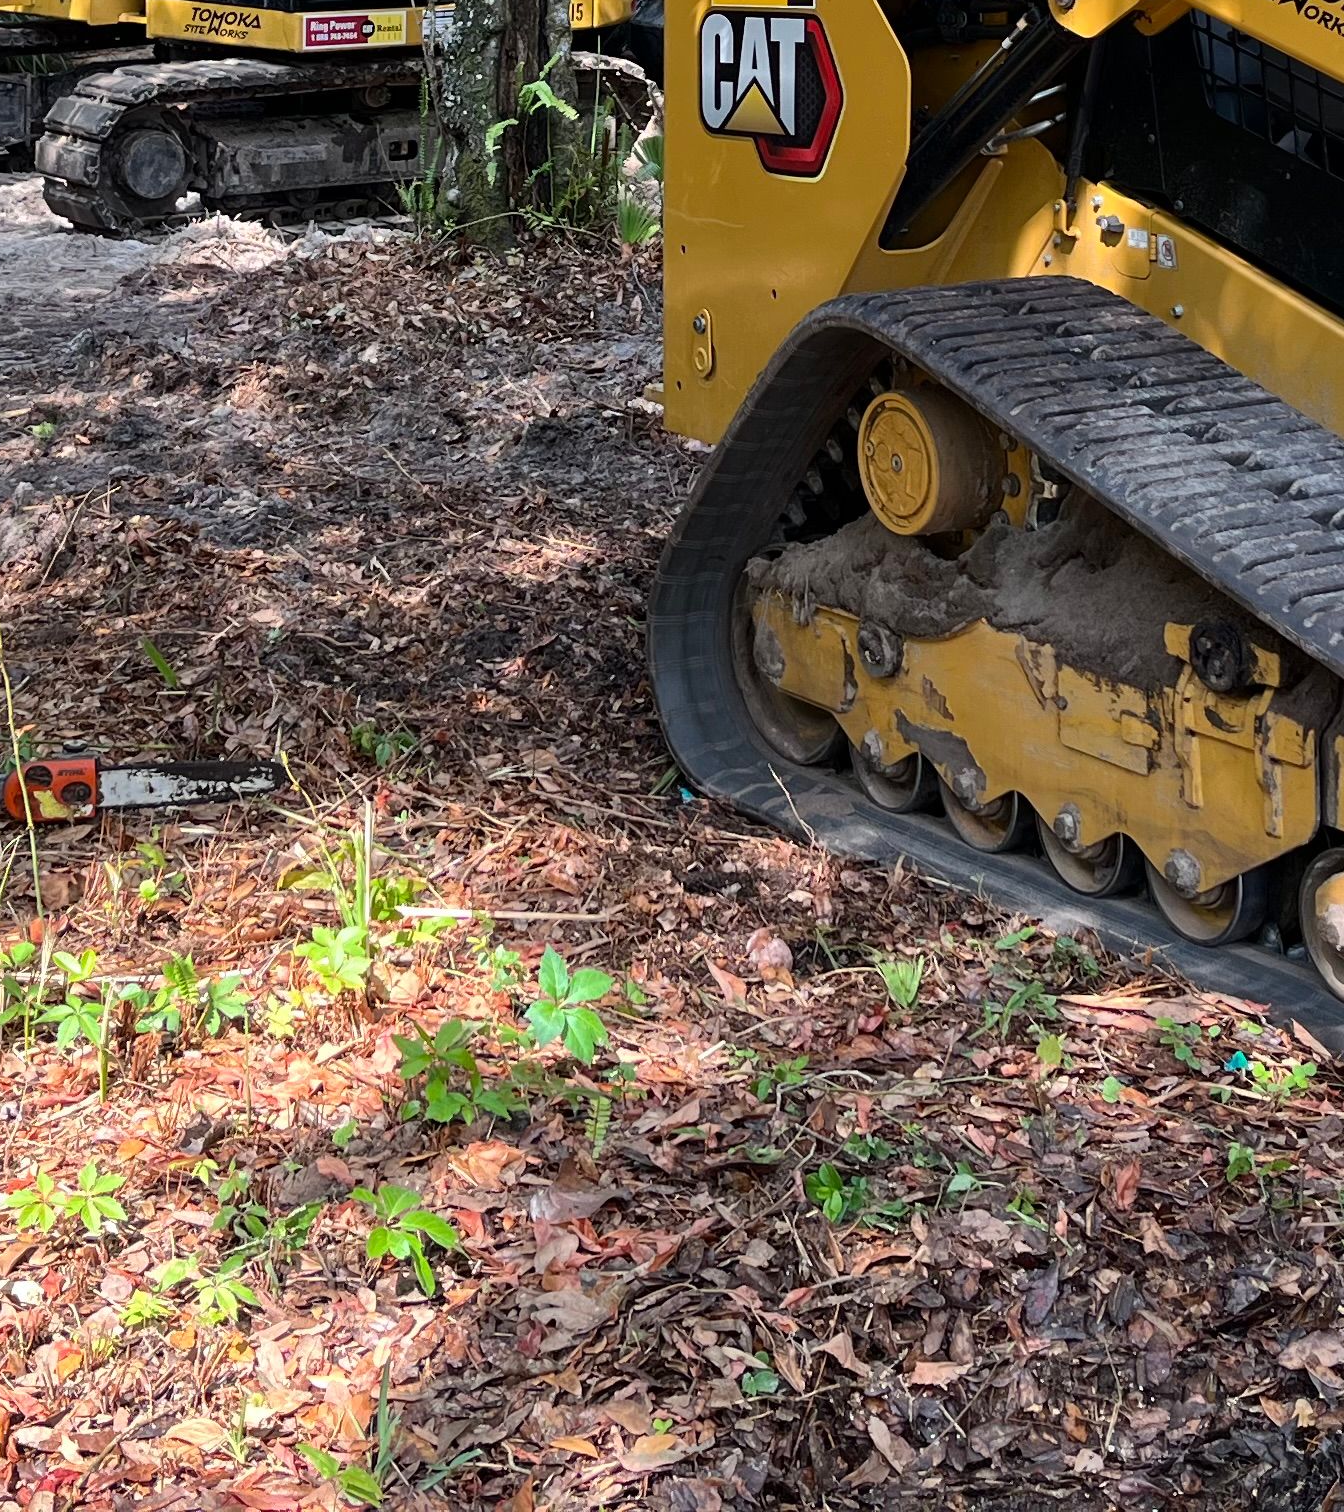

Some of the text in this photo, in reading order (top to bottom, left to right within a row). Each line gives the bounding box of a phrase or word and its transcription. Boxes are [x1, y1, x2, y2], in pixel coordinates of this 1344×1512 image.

[191, 7, 262, 29] TOMOKA
[183, 24, 249, 39] SITE WORKS
[310, 20, 358, 33] Ring Power
[376, 24, 403, 32] Rental
[700, 13, 805, 137] CAT
